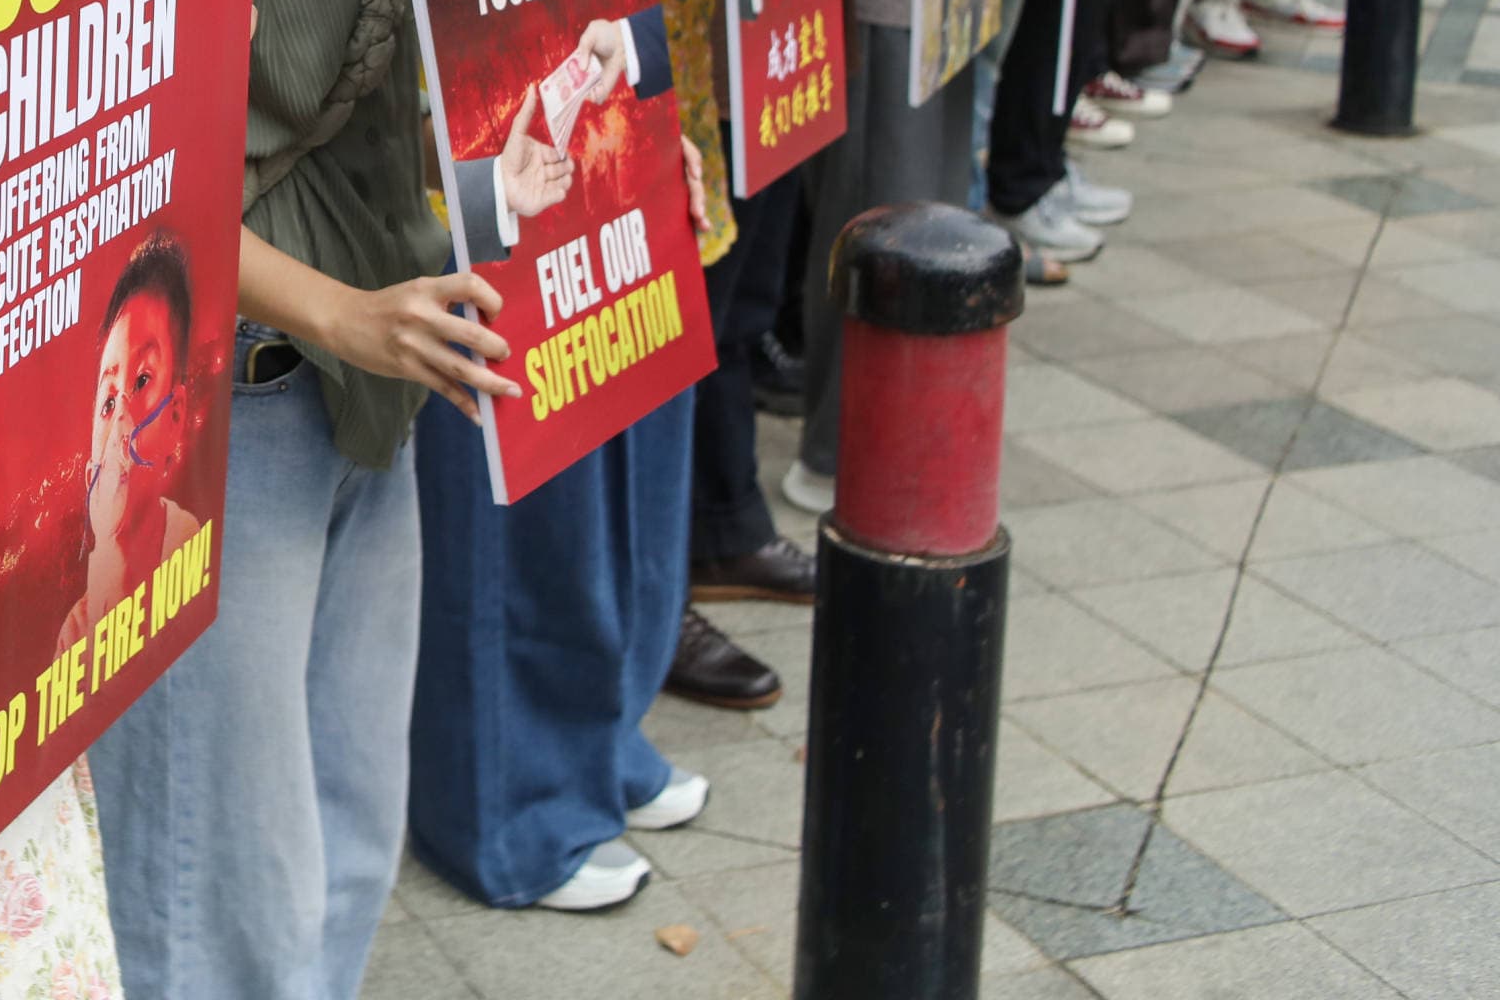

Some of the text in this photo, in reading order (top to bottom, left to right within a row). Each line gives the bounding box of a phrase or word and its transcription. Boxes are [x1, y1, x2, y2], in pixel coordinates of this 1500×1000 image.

[95, 104, 150, 186] FROM
[49, 149, 175, 278] RESPIRATORY
[536, 207, 652, 329] FUEL OUR
[525, 269, 684, 421] SUFFOCATION
[36, 636, 87, 747] THE
[91, 580, 147, 696] FIRE
[150, 518, 213, 638] NOW!
